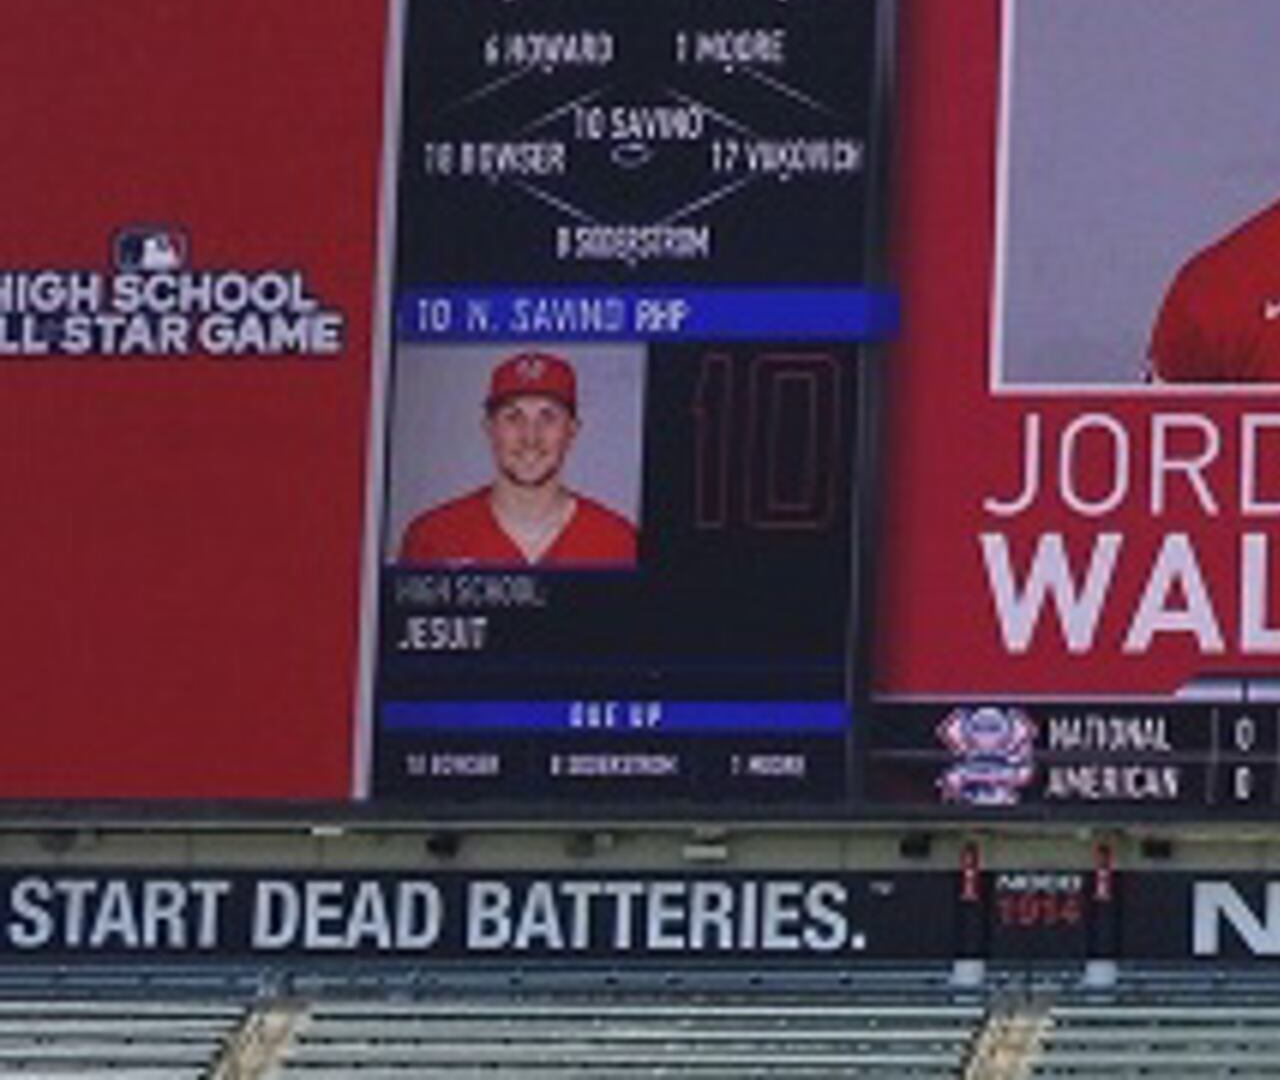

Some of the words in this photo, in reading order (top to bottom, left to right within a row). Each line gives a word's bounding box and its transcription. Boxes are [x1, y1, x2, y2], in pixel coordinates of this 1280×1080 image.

[503, 32, 614, 64] HOWARD
[696, 30, 785, 62] MOORE
[611, 106, 703, 139] SAVINO
[112, 272, 318, 313] SCHOOL
[418, 298, 450, 332] 10
[511, 298, 625, 332] SAVINO
[635, 298, 688, 332] RHP
[0, 317, 47, 353] LL
[199, 314, 343, 354] GAME
[397, 617, 488, 650] JESUIT
[568, 701, 618, 728] DUE
[628, 701, 663, 728] UP
[1049, 717, 1171, 752] NATIONAL
[1235, 718, 1255, 752] 0
[1043, 767, 1179, 800] AMERICAN
[10, 880, 229, 950] START
[252, 881, 441, 950] DEAD
[998, 893, 1080, 926] 1914
